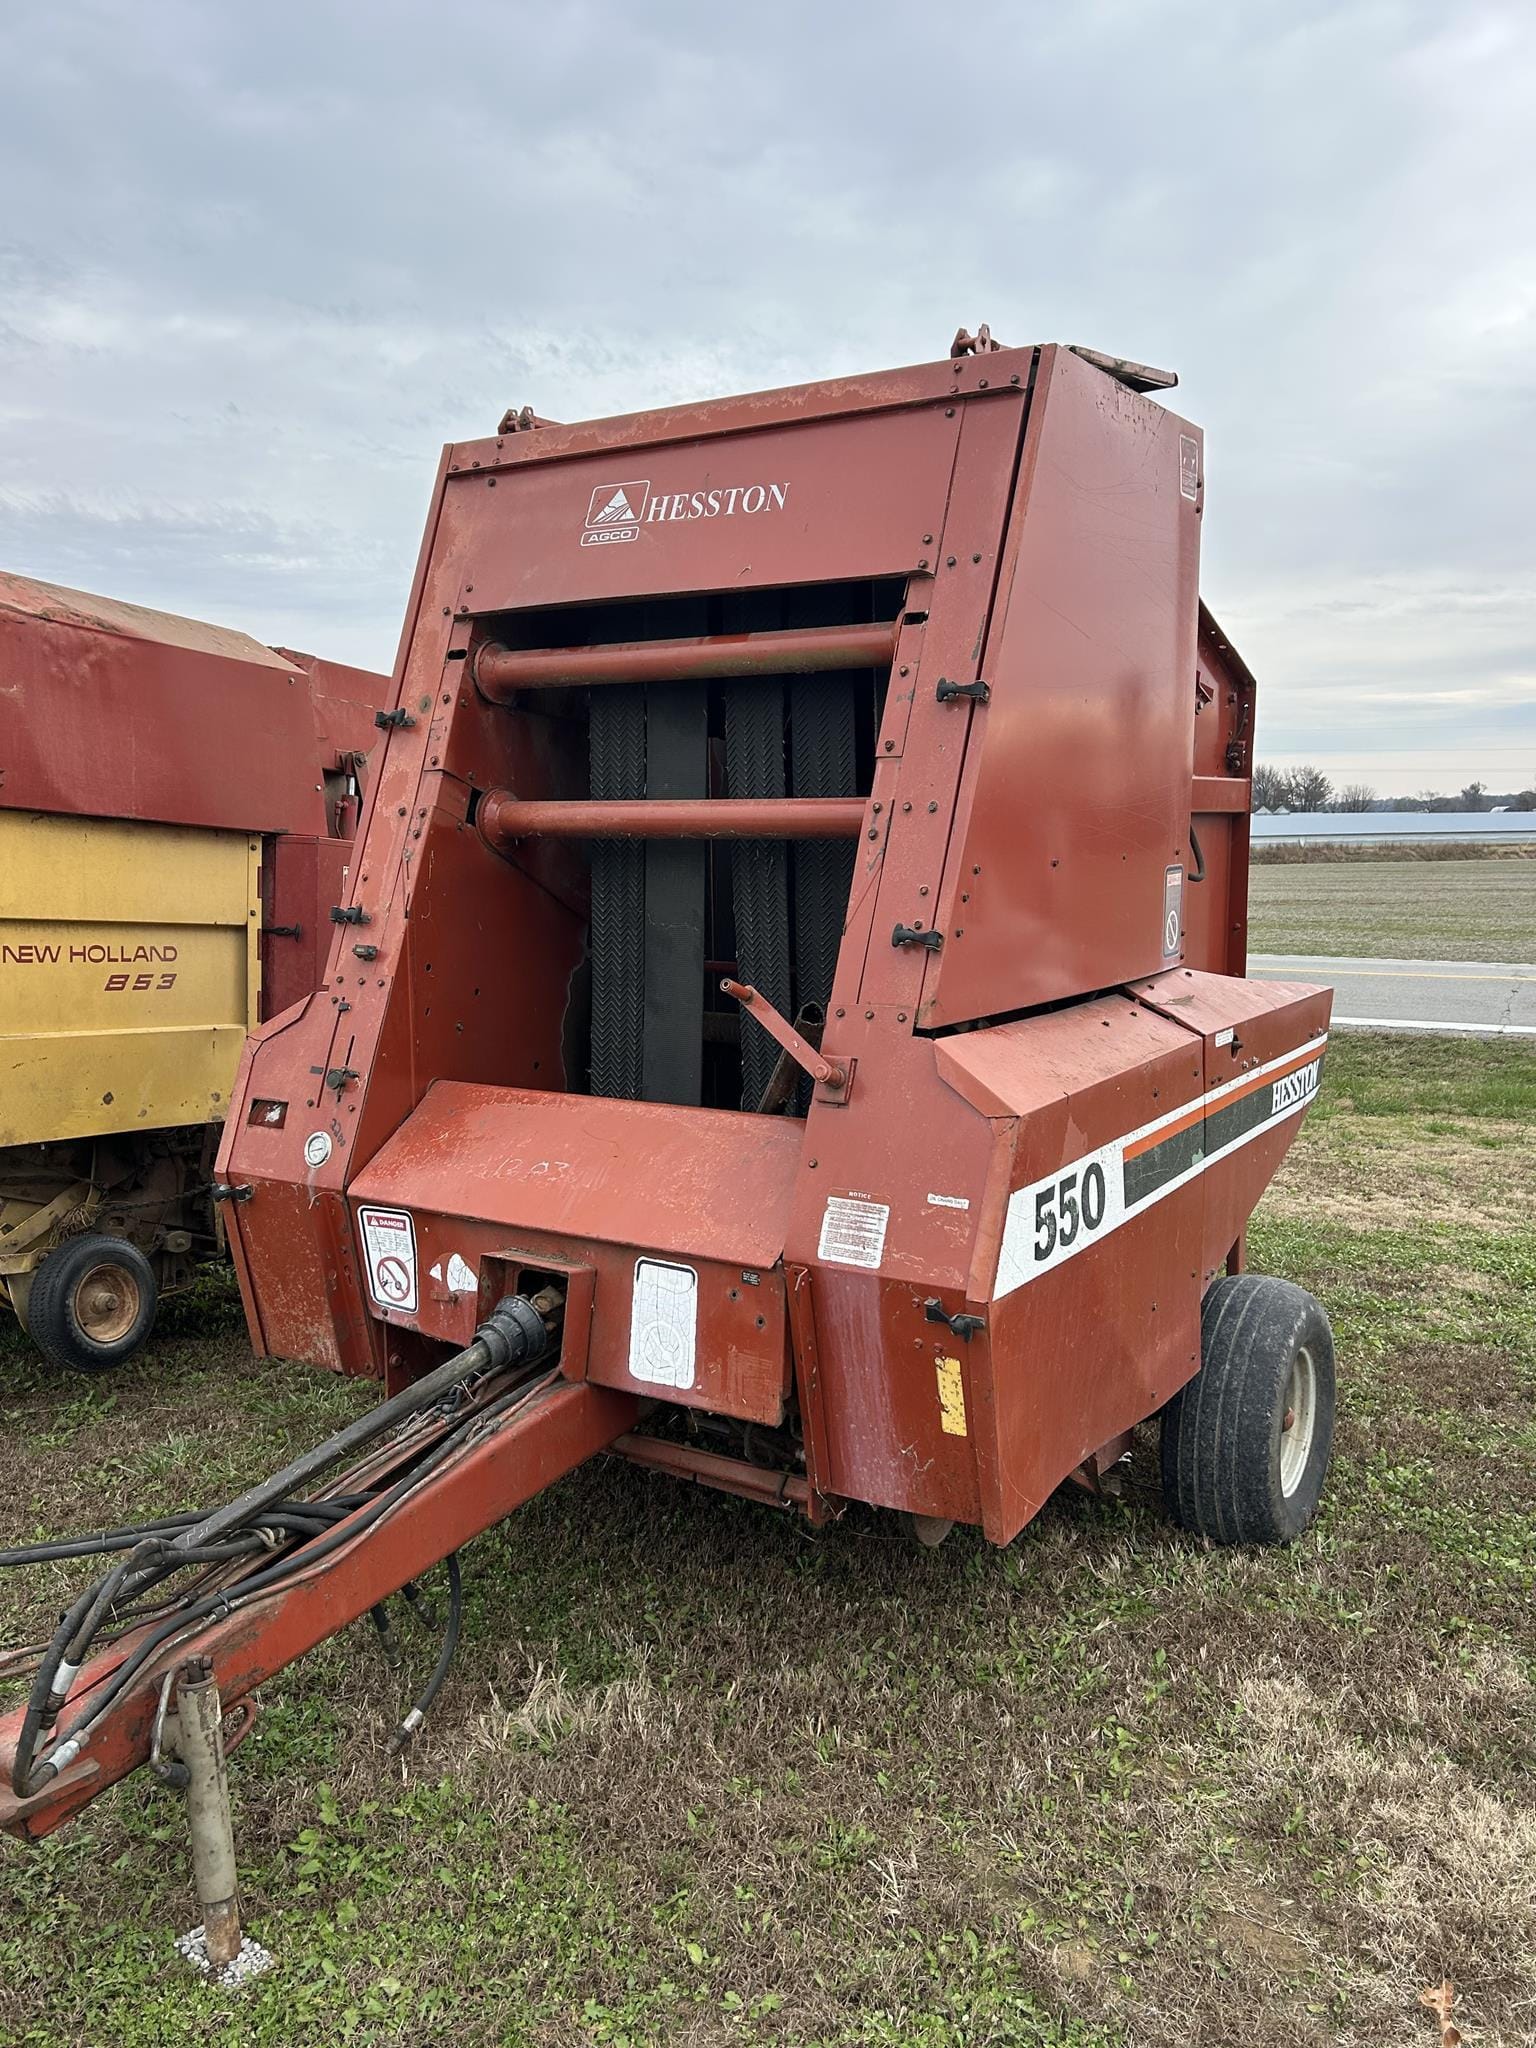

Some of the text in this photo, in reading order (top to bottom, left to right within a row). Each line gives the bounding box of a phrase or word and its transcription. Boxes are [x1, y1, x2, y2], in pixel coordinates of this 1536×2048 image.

[645, 482, 791, 523] HESSTON
[588, 530, 632, 543] AGCO
[2, 944, 178, 963] NEW HOLLAND
[104, 973, 178, 991] 853
[1271, 1057, 1320, 1115] HESSTON
[848, 1191, 872, 1200] NOTICE
[1034, 1162, 1106, 1261] 550
[379, 1219, 404, 1229] DANGER
